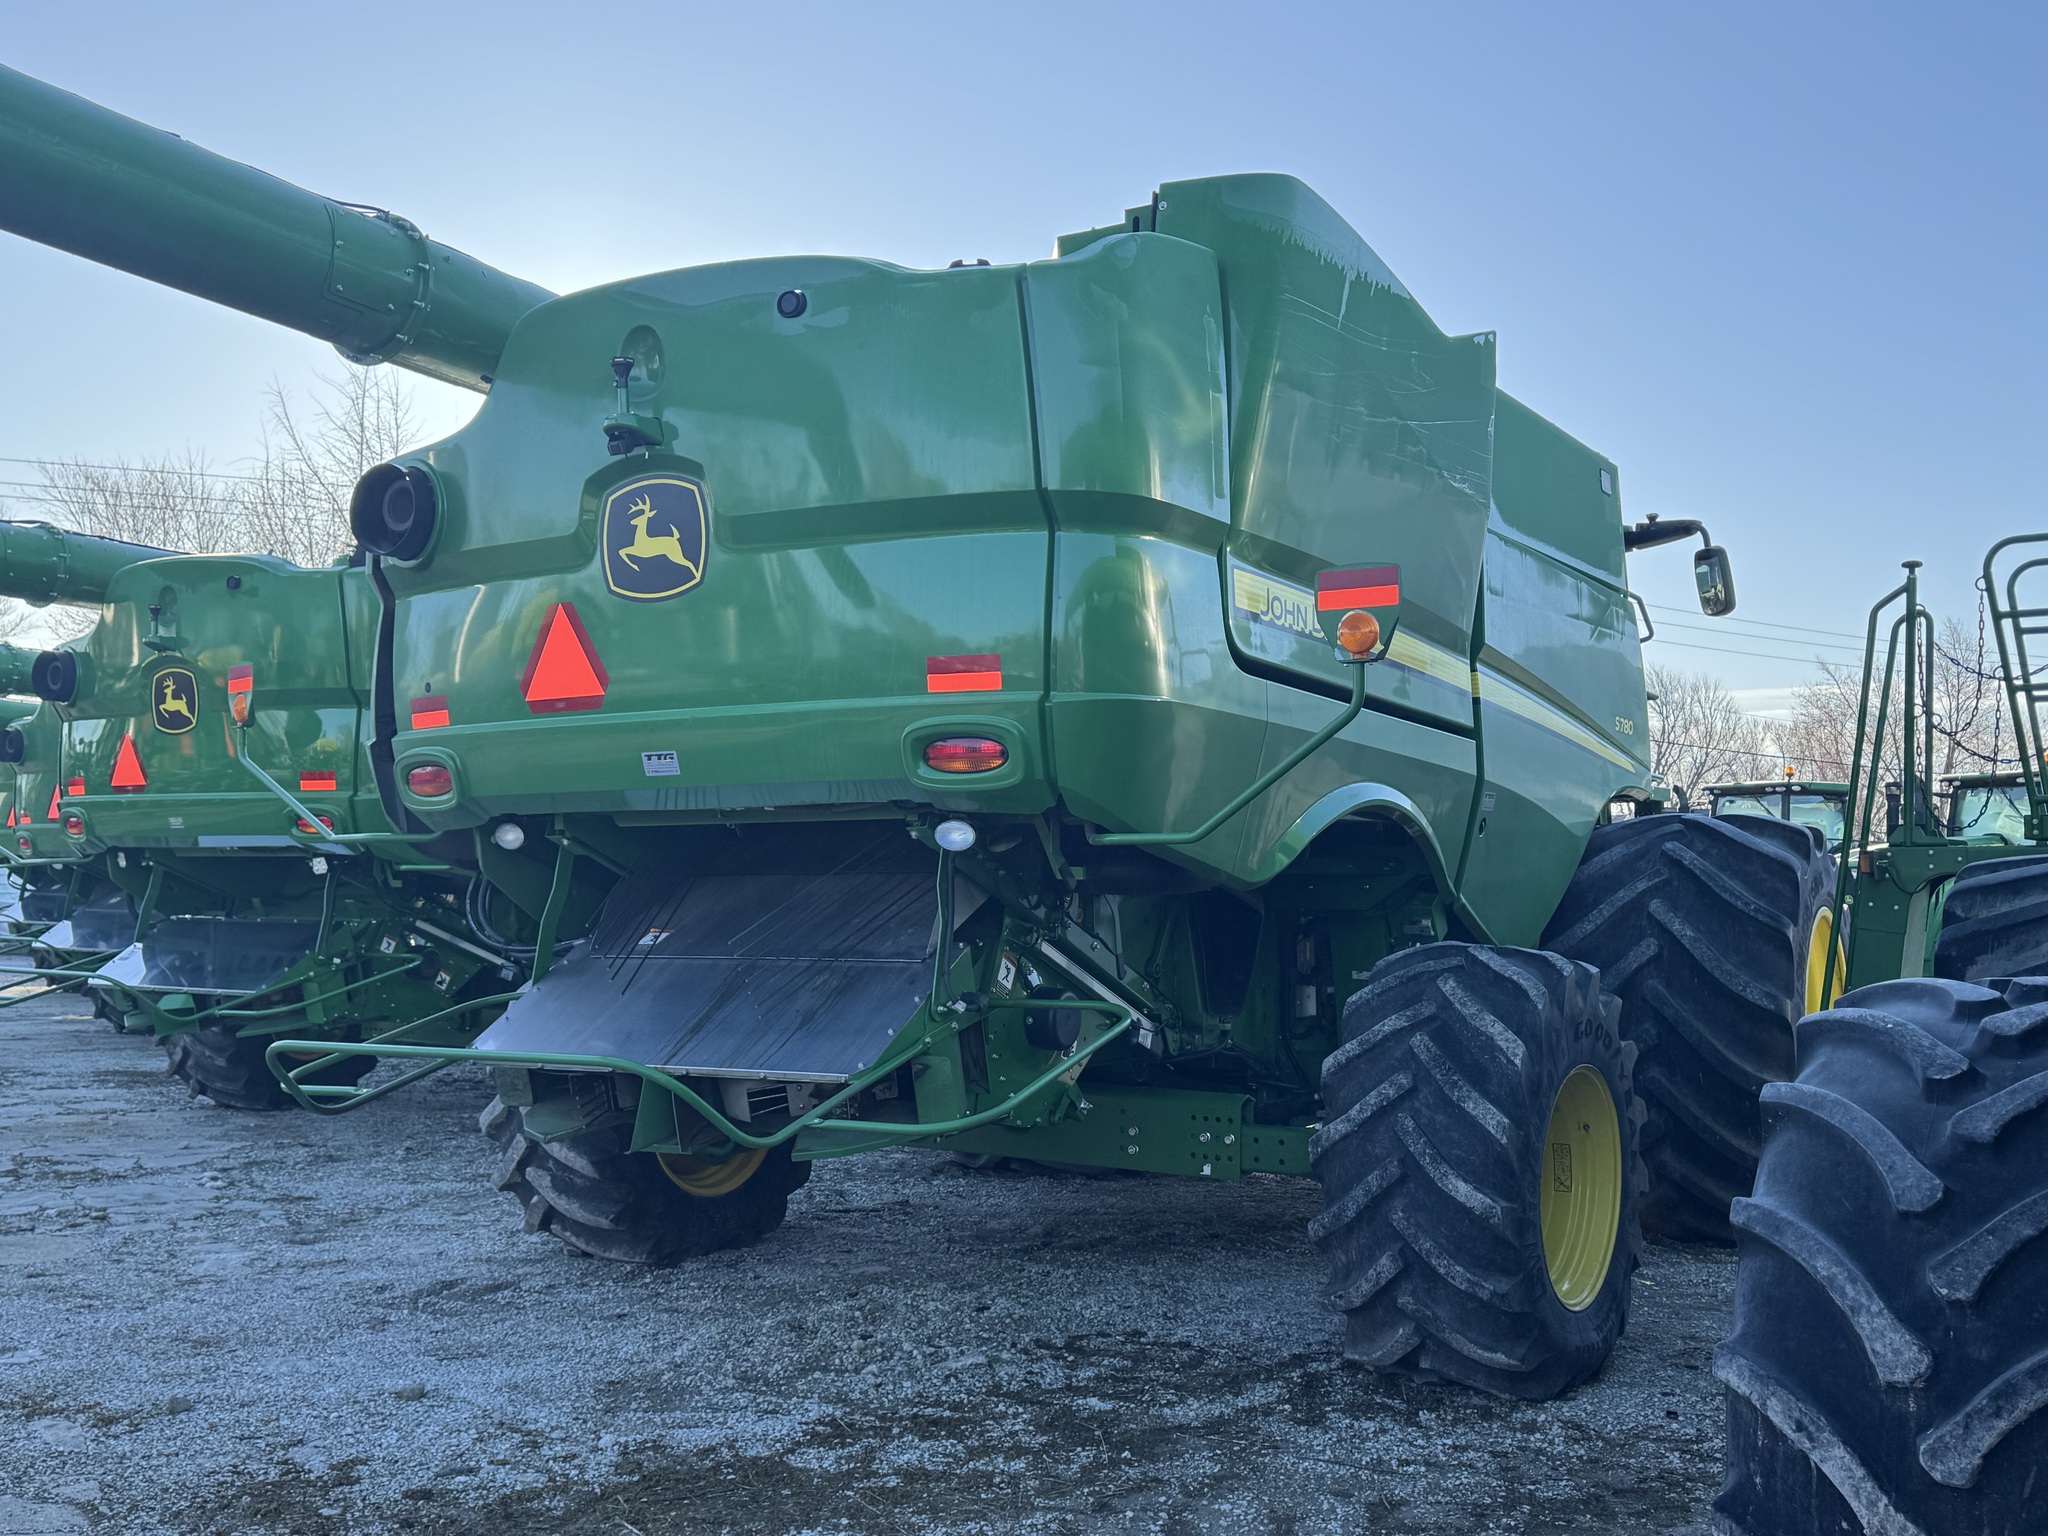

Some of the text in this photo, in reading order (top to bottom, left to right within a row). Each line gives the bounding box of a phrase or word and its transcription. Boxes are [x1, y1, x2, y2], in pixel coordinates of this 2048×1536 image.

[1260, 587, 1309, 631] JOHN
[1615, 716, 1634, 736] S780
[644, 753, 675, 763] TTG
